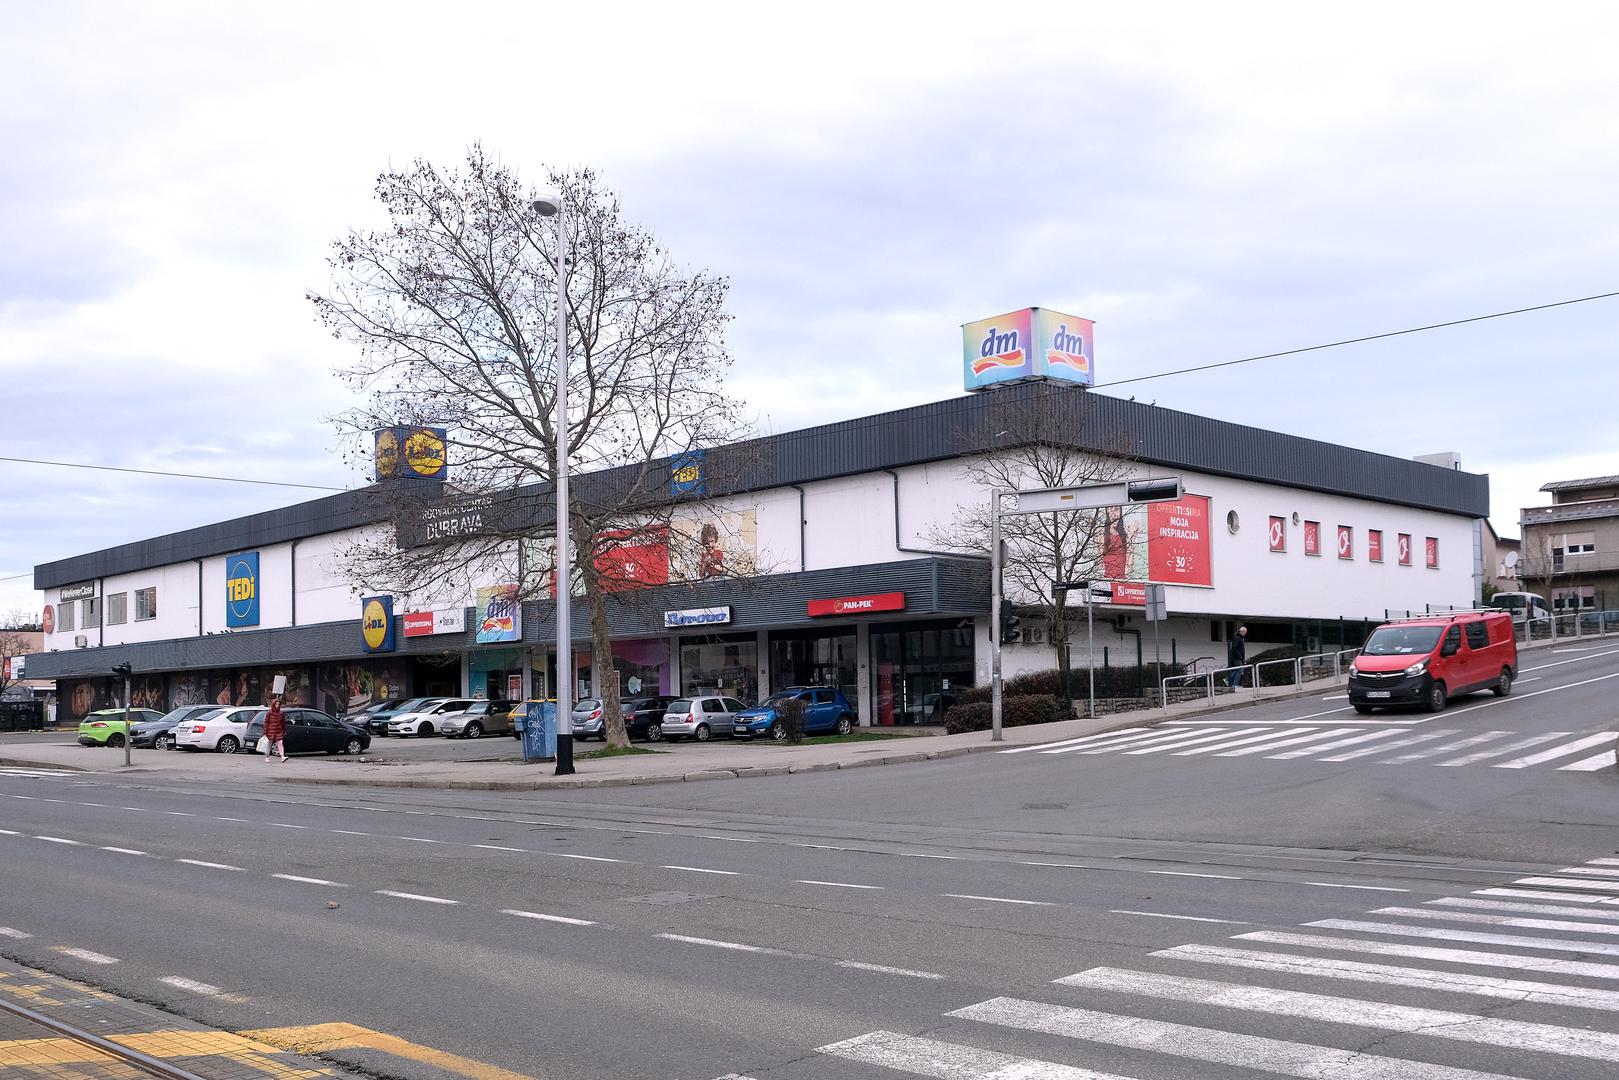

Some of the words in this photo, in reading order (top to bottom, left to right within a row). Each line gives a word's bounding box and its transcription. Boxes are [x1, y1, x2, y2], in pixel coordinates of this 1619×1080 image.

[981, 328, 1018, 357] dm
[1053, 325, 1083, 355] dm
[426, 514, 483, 541] DUBRAVA
[1160, 528, 1199, 540] INSPIRACIJA
[1170, 517, 1189, 527] MOJA
[1175, 556, 1186, 567] 30
[227, 576, 255, 602] TEDi
[487, 596, 509, 618] dm
